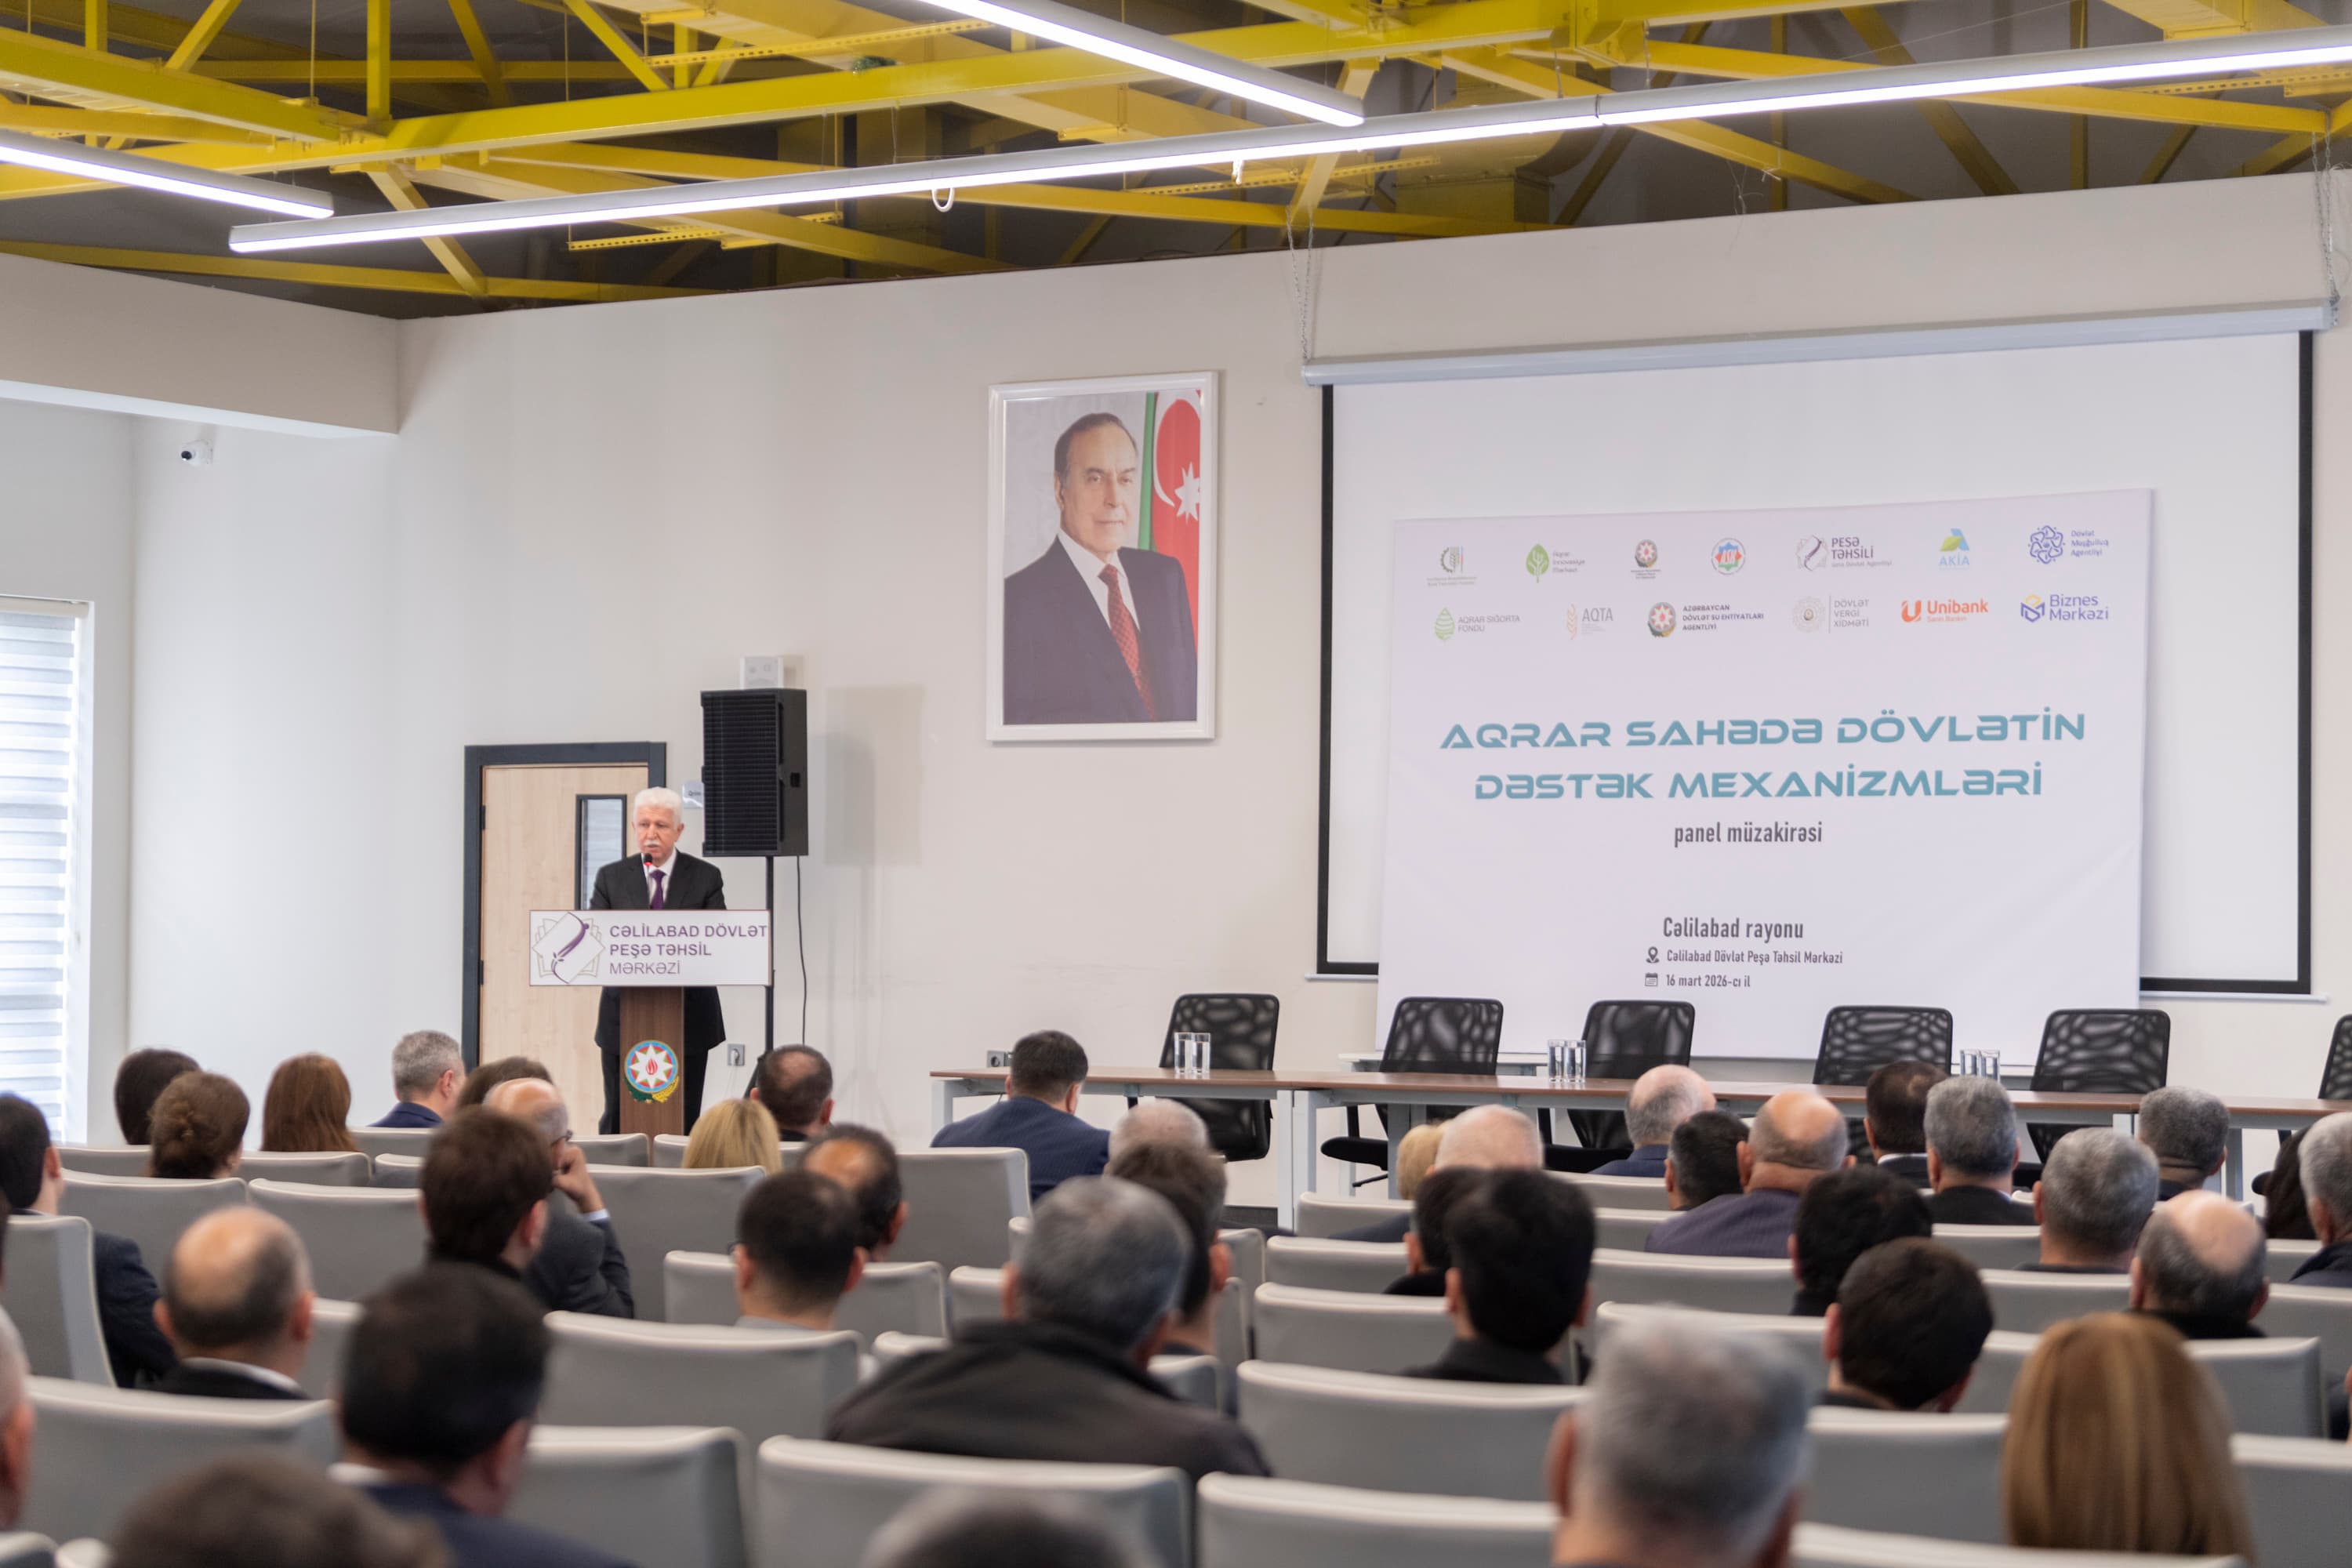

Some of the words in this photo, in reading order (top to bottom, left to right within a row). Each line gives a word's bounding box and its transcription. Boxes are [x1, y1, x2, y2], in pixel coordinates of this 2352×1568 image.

[1831, 546, 1873, 559] TƏHSİLİ
[1939, 553, 1970, 565] AKİA
[1927, 599, 1988, 615] Unibank
[2050, 593, 2098, 607] Biznes
[1582, 608, 1613, 622] AQTA
[1834, 608, 1860, 617] VERGİ
[1440, 722, 1610, 749] AQRAR
[1627, 719, 1822, 746] SAHƏDƏ
[1838, 707, 2084, 743] DÖVLƏTİN
[1475, 774, 1653, 799] DƏSTƏK
[1668, 761, 2041, 798] MEXANİZMLƏRİ
[1675, 822, 1721, 848] panel
[1728, 822, 1822, 842] müzakirəsi
[609, 923, 699, 938] CƏLİLABAD
[705, 922, 767, 938] DÖVLƏT
[1664, 917, 1739, 938] Cəlilabad
[1746, 924, 1803, 943] rayonu
[610, 944, 651, 958] PEŞƏ
[656, 942, 711, 956] TƏHSİL
[1668, 949, 1711, 962] Cəlilabad
[1715, 950, 1744, 962] Dövlət
[1748, 950, 1769, 965] Peşə
[1773, 951, 1801, 963] Təhsil
[1804, 951, 1842, 964] Mərkəzi
[610, 960, 680, 975] MƏRKƏZİ
[1667, 975, 1675, 986] 16
[1679, 975, 1701, 986] mart
[1704, 975, 1740, 987] 2026-cı
[1744, 975, 1750, 987] il
